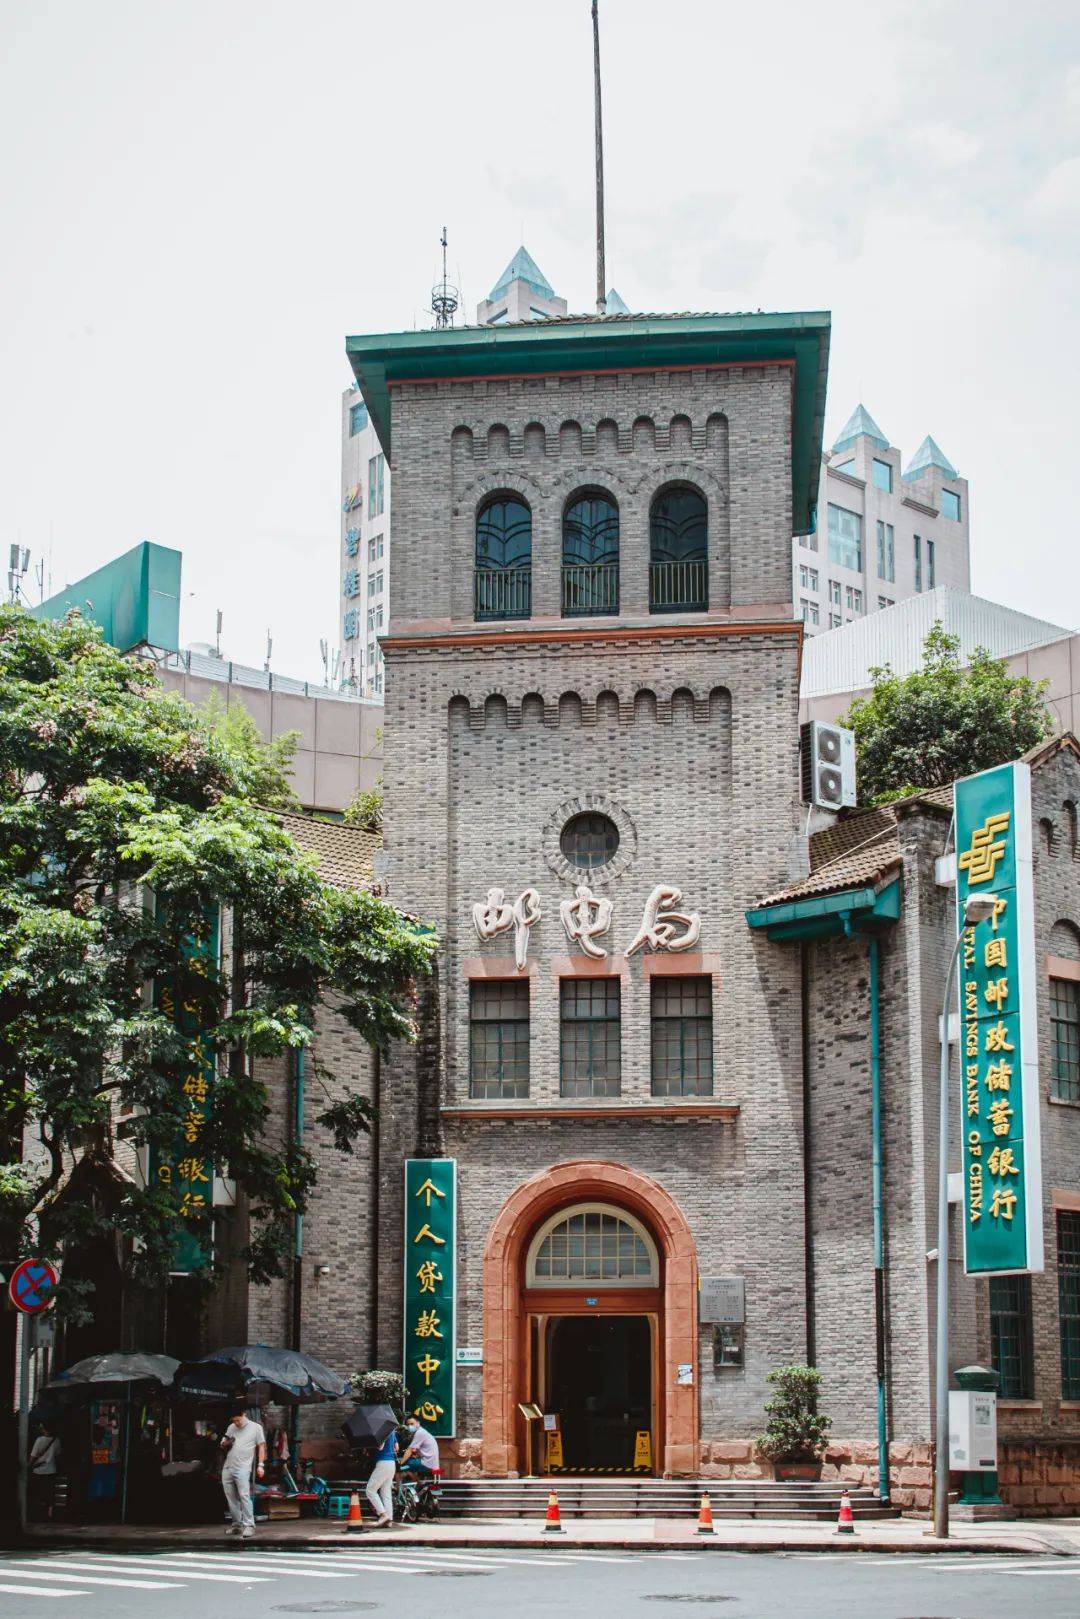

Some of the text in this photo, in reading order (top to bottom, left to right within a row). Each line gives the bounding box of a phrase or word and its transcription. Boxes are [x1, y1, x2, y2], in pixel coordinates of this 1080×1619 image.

[965, 981, 979, 1057] SAVINGS
[966, 1064, 979, 1118] BANK
[968, 1131, 982, 1157] OF
[969, 1163, 983, 1223] CHINA
[413, 1178, 446, 1422] 个人贷款中心
